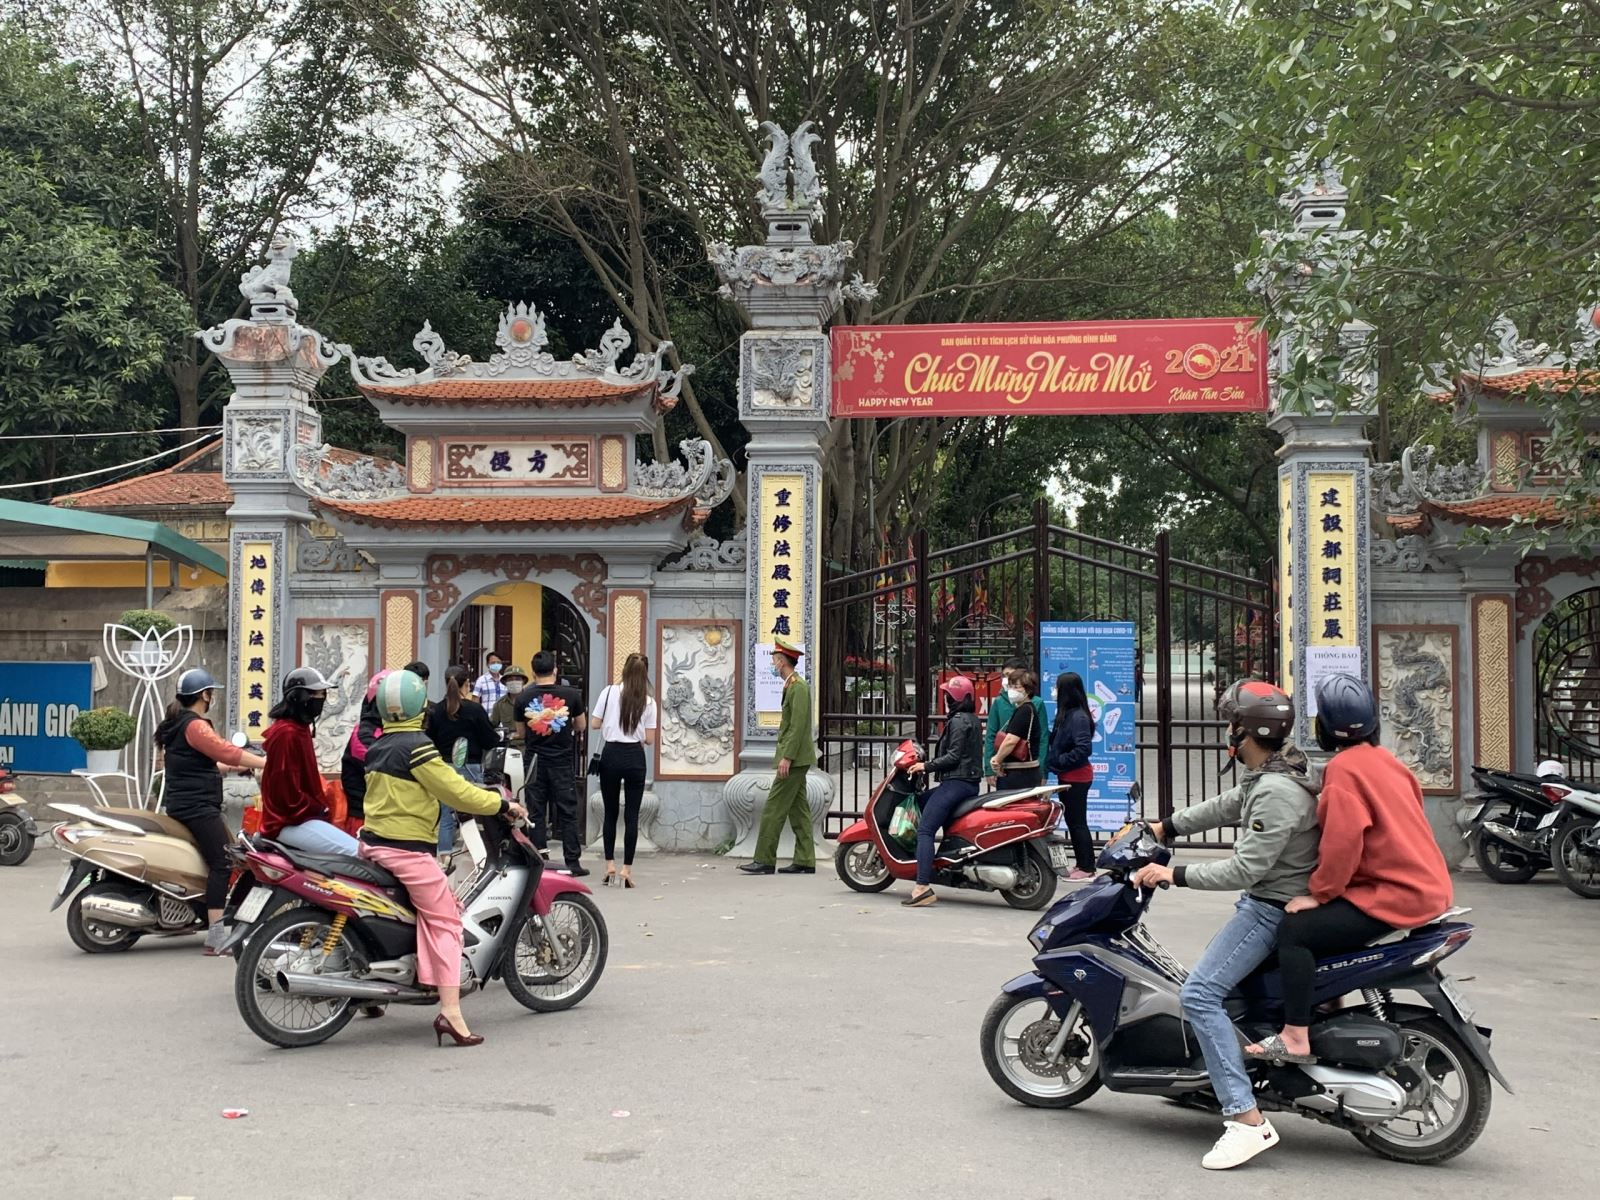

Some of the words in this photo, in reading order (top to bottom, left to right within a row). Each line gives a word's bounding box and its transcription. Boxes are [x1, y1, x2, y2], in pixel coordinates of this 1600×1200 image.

[941, 338, 954, 346] BAN
[955, 336, 972, 346] QUẢN
[973, 336, 980, 345] LÝ
[982, 337, 988, 345] DI
[990, 336, 1003, 345] TÍCH
[1004, 336, 1018, 346] LỊCH
[1020, 334, 1028, 345] SỬ
[1029, 334, 1042, 344] VĂN
[1043, 334, 1055, 344] HÓA
[1057, 333, 1082, 344] PHƯỜNG
[1083, 332, 1098, 344] ĐÌNH
[1100, 332, 1117, 343] BẢNG
[904, 352, 965, 394] Chúc
[956, 352, 1038, 404] Mừng
[1026, 351, 1099, 393] Năm
[1090, 352, 1157, 393] Mới
[858, 397, 887, 407] HAPPY
[889, 397, 909, 406] NEW
[910, 397, 933, 406] YEAR
[1168, 387, 1198, 404] Xuân
[1200, 387, 1218, 400] Tân
